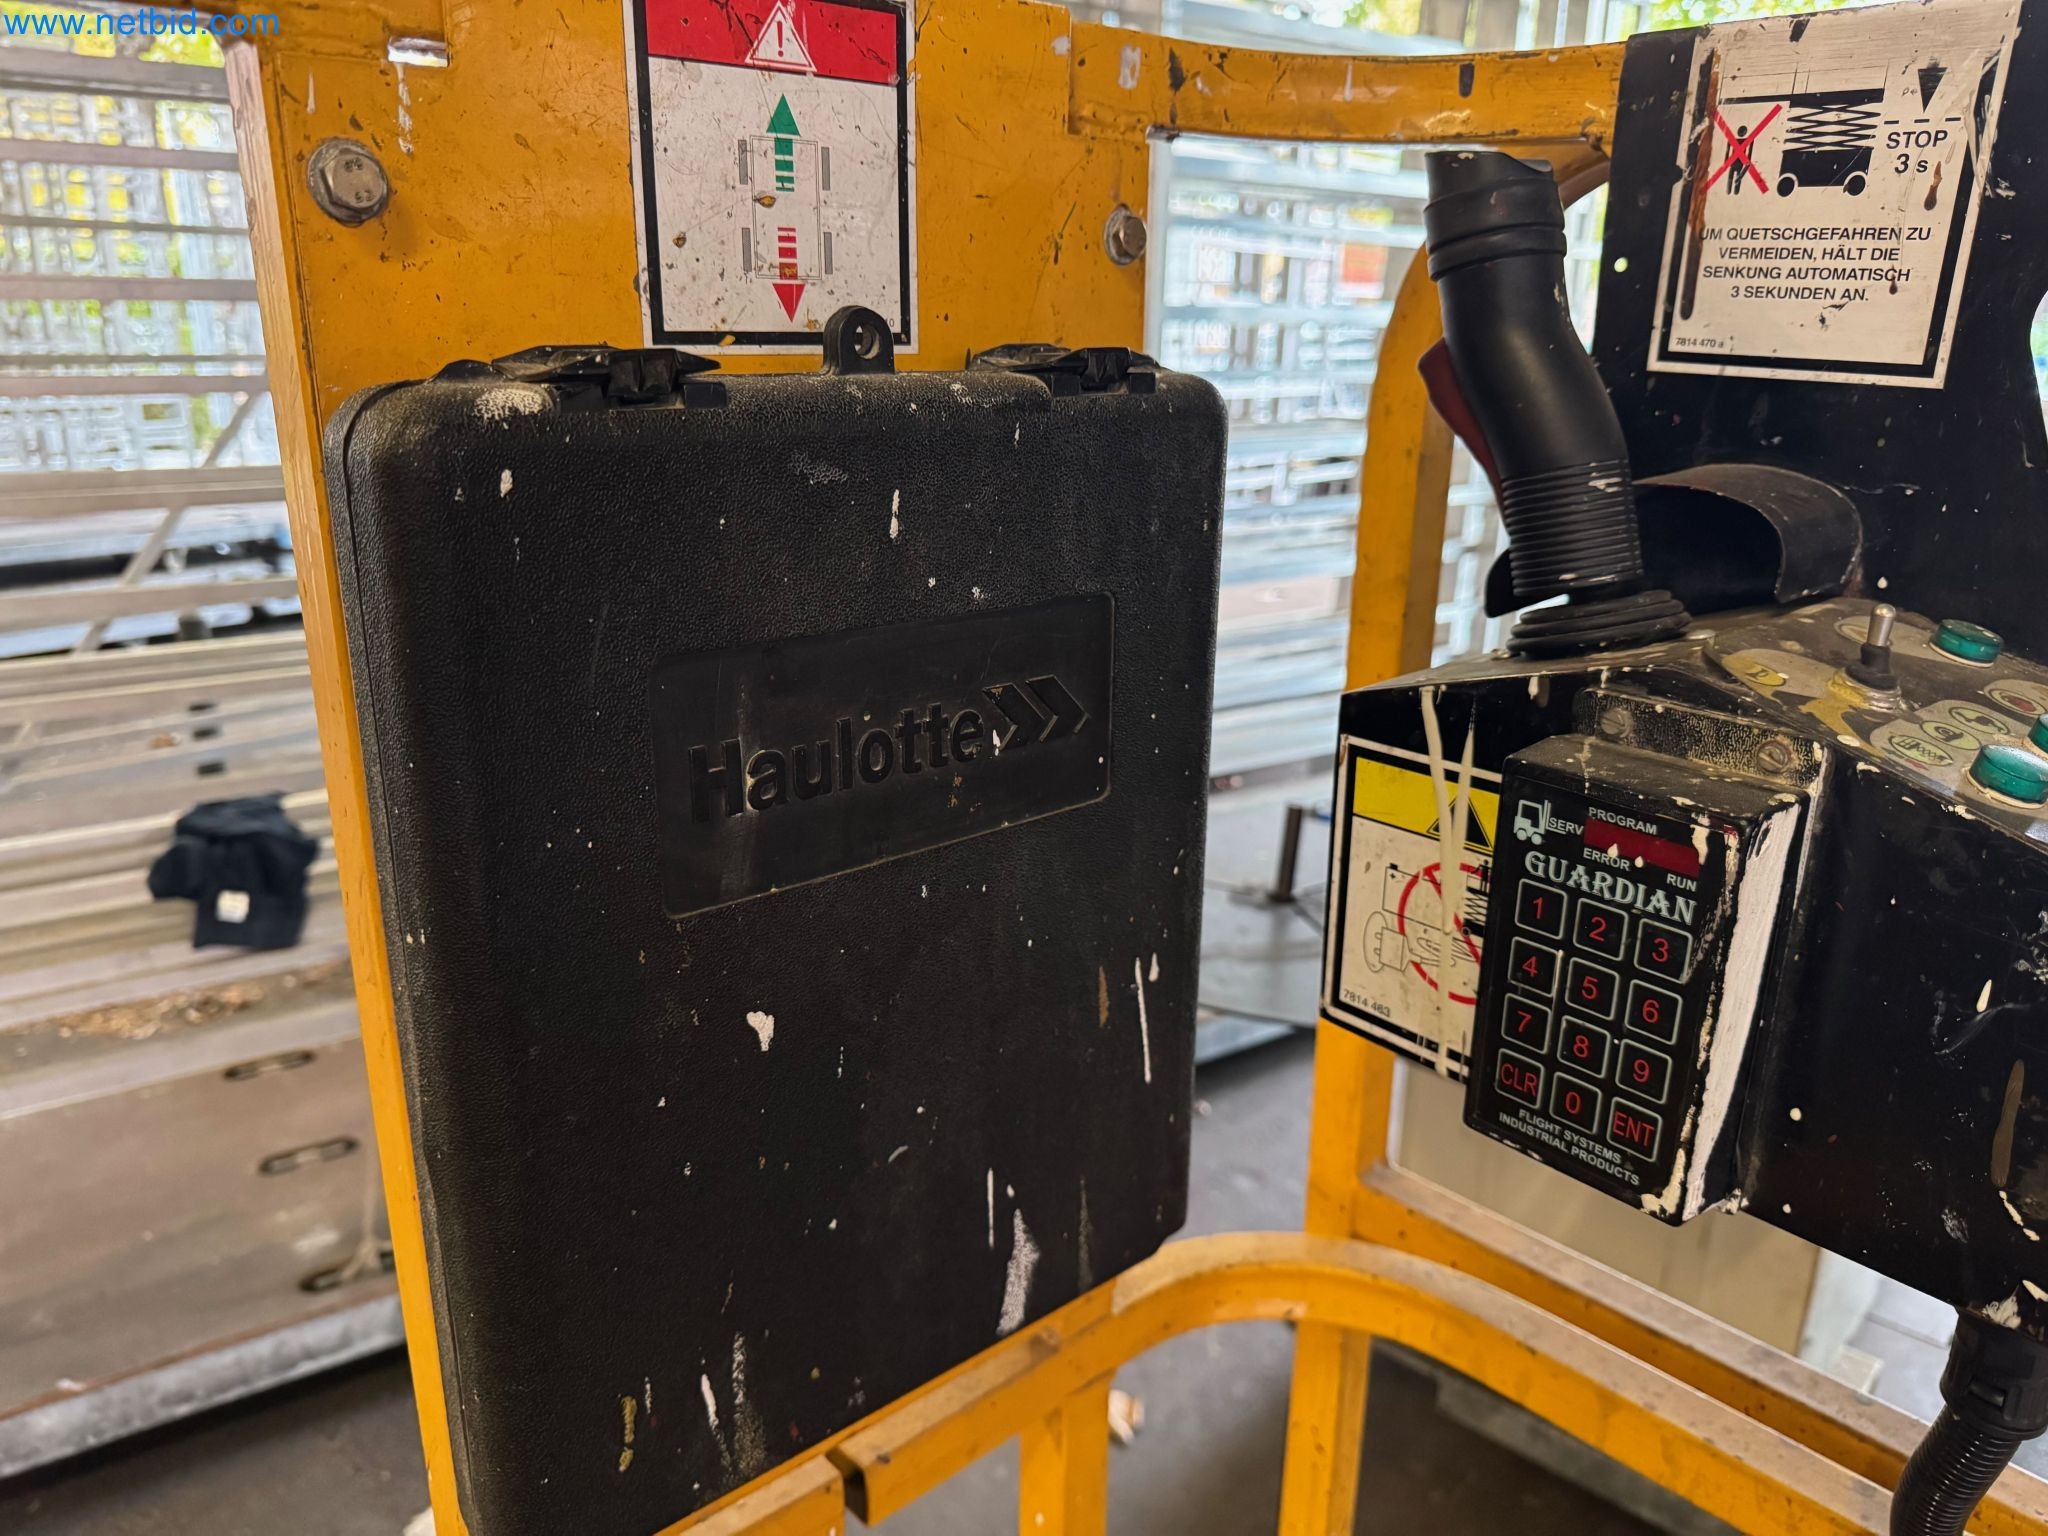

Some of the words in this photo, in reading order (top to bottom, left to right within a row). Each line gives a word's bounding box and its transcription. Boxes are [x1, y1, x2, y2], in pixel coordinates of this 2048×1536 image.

[1886, 130, 1948, 149] STOP
[1894, 153, 1910, 174] 3
[1916, 159, 1929, 173] s
[1727, 228, 1902, 241] QUETSCHGEFAHREN
[1906, 227, 1932, 241] ZU
[1718, 247, 1817, 263] VERMEIDEN,
[1821, 244, 1867, 261] HÄLT
[1870, 248, 1900, 261] DIE
[1703, 266, 1781, 279] SENKUNG
[1785, 267, 1911, 282] AUTOMATISCH
[1730, 286, 1740, 298] 3
[1743, 286, 1836, 300] SEKUNDEN
[1840, 288, 1869, 301] AN.
[687, 702, 985, 823] Haulotte
[1549, 817, 1584, 836] SERV
[1588, 806, 1658, 835] PROGRAM
[1583, 847, 1630, 872] ERROR
[1524, 850, 1697, 926] GUARDIAN
[1667, 873, 1697, 892] RUN
[1532, 897, 1544, 920] 1
[1589, 916, 1608, 942] 2
[1651, 937, 1670, 963] 3
[1522, 955, 1539, 978] 4
[1581, 976, 1599, 1000] 5
[1517, 1010, 1532, 1033] 7
[1642, 999, 1661, 1024] 6
[1573, 1034, 1590, 1058] 8
[1500, 1063, 1538, 1097] CLR
[1632, 1058, 1650, 1083] 9
[1565, 1091, 1581, 1115] 0
[1518, 1108, 1562, 1136] FLIGHT
[1563, 1129, 1623, 1165] SYSTEMS
[1612, 1110, 1655, 1147] ENT
[1499, 1111, 1569, 1153] INDUSTRIAL
[1570, 1144, 1641, 1186] PRODUCTS
